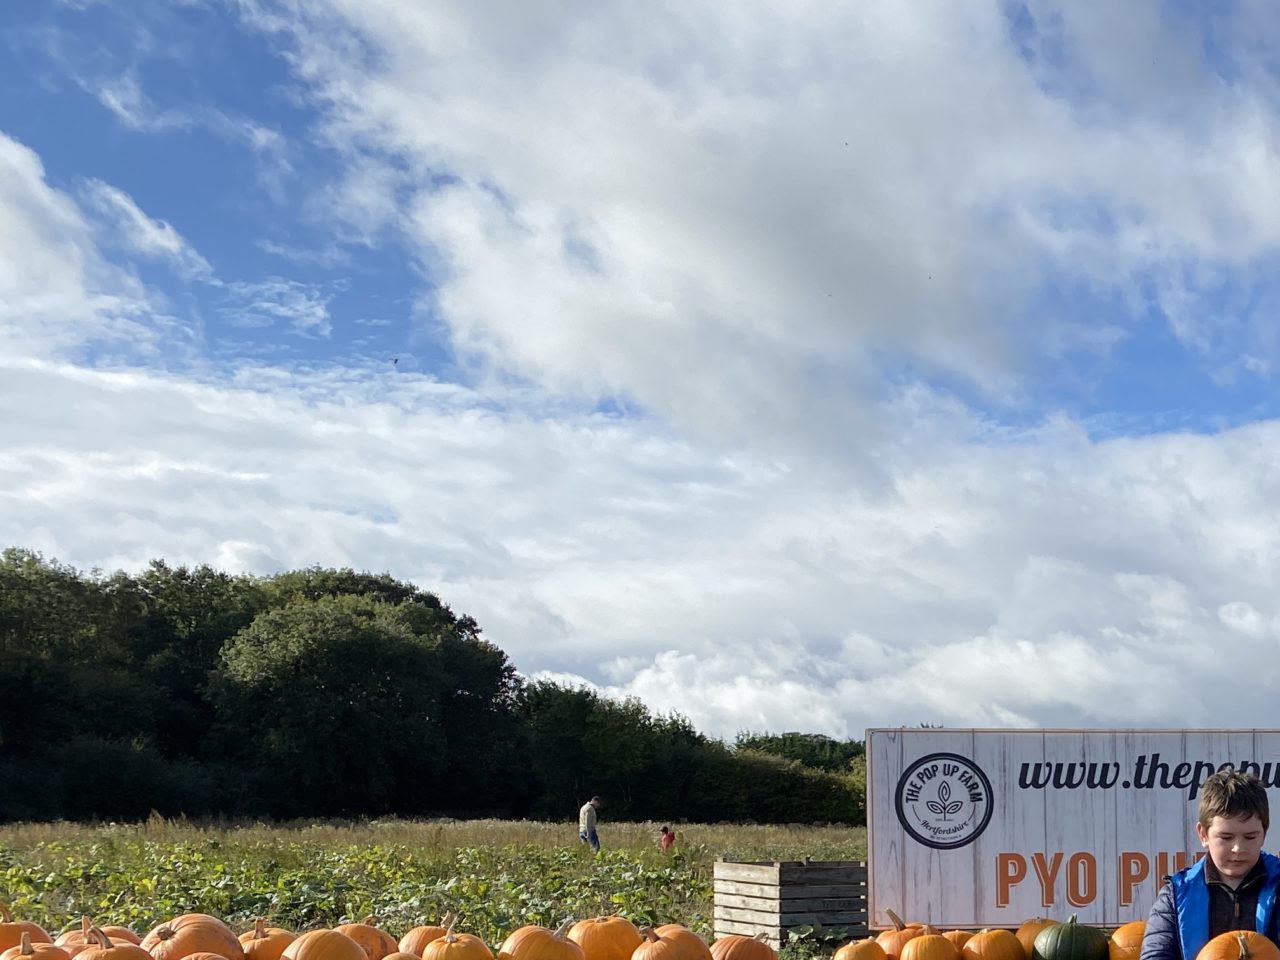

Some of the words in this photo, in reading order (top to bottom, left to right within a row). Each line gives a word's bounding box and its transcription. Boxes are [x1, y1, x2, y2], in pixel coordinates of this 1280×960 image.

[905, 781, 923, 804] THE
[916, 764, 939, 785] POP
[943, 763, 960, 777] UP
[958, 770, 983, 803] FARM
[921, 820, 969, 835] Hertfordshire
[995, 852, 1098, 908] PYO
